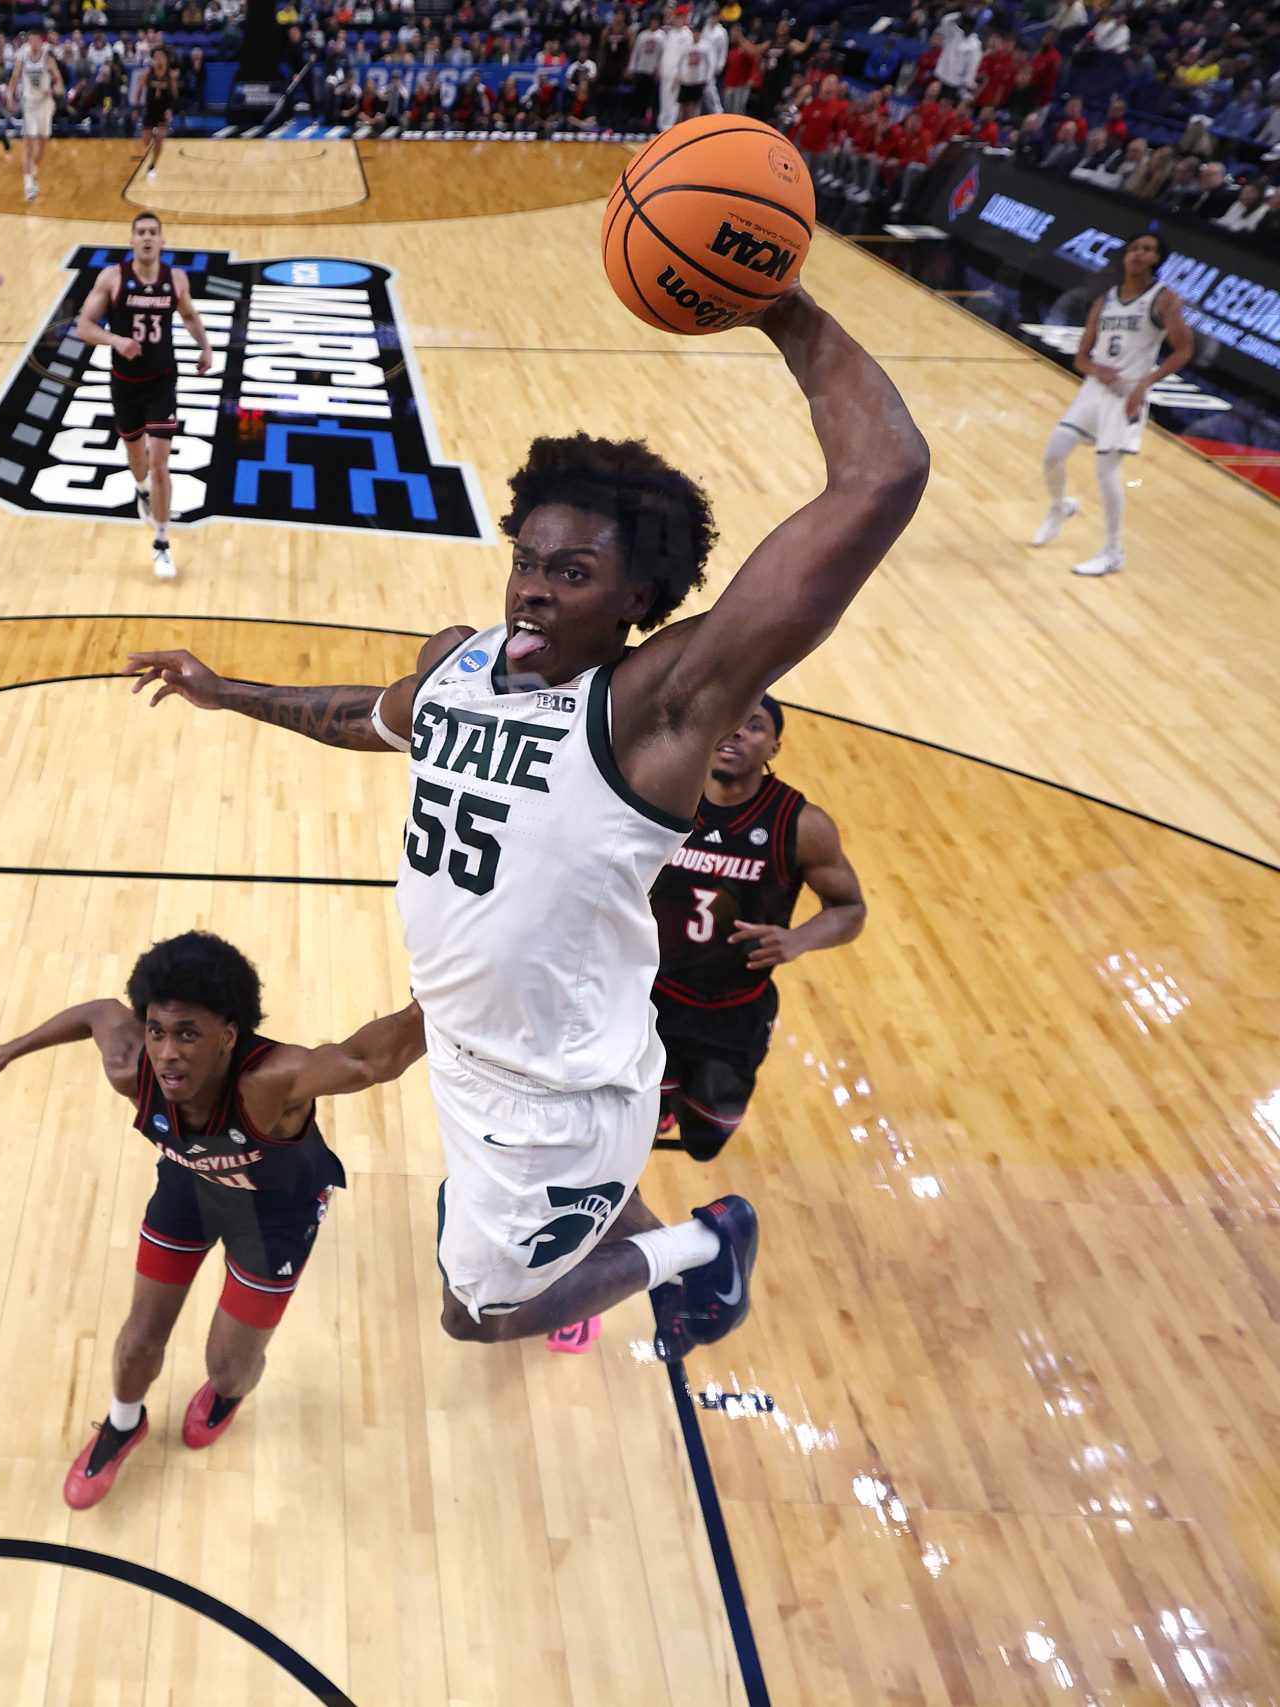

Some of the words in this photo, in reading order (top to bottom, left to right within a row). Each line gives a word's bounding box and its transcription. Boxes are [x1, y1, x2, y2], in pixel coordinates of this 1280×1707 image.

[711, 220, 798, 282] NCAA
[1053, 228, 1127, 273] ACC
[656, 264, 742, 328] ilson
[1202, 273, 1280, 341] SECON
[132, 313, 162, 343] 53
[238, 284, 392, 419] MARCH
[1109, 335, 1122, 357] 6
[410, 701, 570, 793] STATE
[406, 777, 511, 896] 55
[666, 847, 766, 881] OUISVILLE
[686, 887, 718, 943] 3
